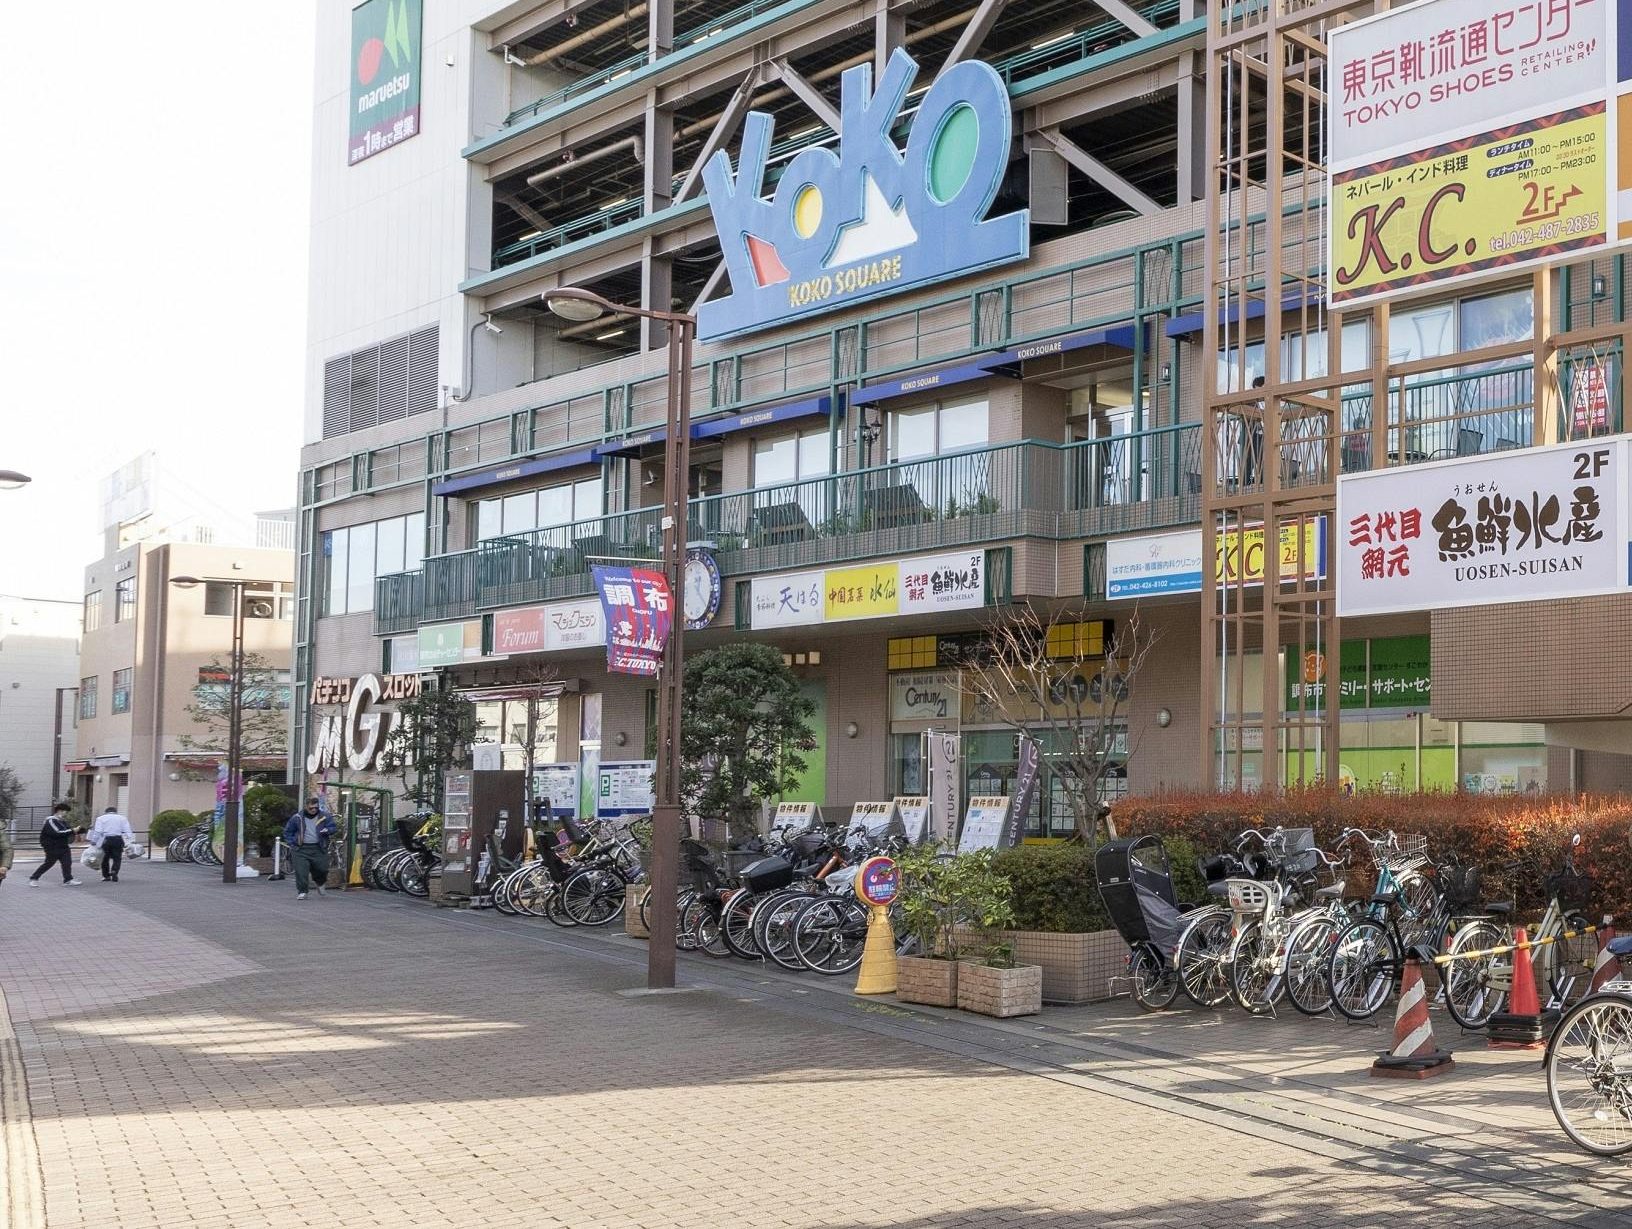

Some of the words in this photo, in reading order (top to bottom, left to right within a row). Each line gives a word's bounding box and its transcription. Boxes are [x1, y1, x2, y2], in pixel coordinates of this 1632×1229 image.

[1521, 40, 1585, 67] RETAILING
[1521, 52, 1585, 77] CENTER
[357, 72, 411, 114] maruetsu
[1343, 91, 1421, 128] TOKYO
[1430, 63, 1514, 103] SHOES
[1489, 139, 1531, 157] ランチタイム
[1488, 161, 1531, 178] ディナータイム
[1522, 181, 1554, 217] 2F
[1336, 182, 1477, 285] K.C.
[1490, 212, 1599, 252] tel.042-487-2835
[788, 276, 832, 308] KOKO
[834, 255, 902, 295] SQUARE
[1017, 348, 1035, 359] KOKO
[1036, 341, 1062, 355] SQUARE
[1573, 450, 1610, 480] 2F
[1454, 480, 1498, 497] うおせん
[1349, 507, 1422, 547] 三代目
[1431, 486, 1603, 562] 魚鮮水産
[970, 556, 981, 567] 2F
[1455, 555, 1584, 582] UOSEN-SUISAN
[603, 584, 668, 611] 調布
[502, 626, 539, 648] Forum
[310, 676, 350, 705] パチンコ
[905, 687, 941, 707] Century
[936, 699, 947, 717] 21
[971, 798, 1001, 808] 物件情報
